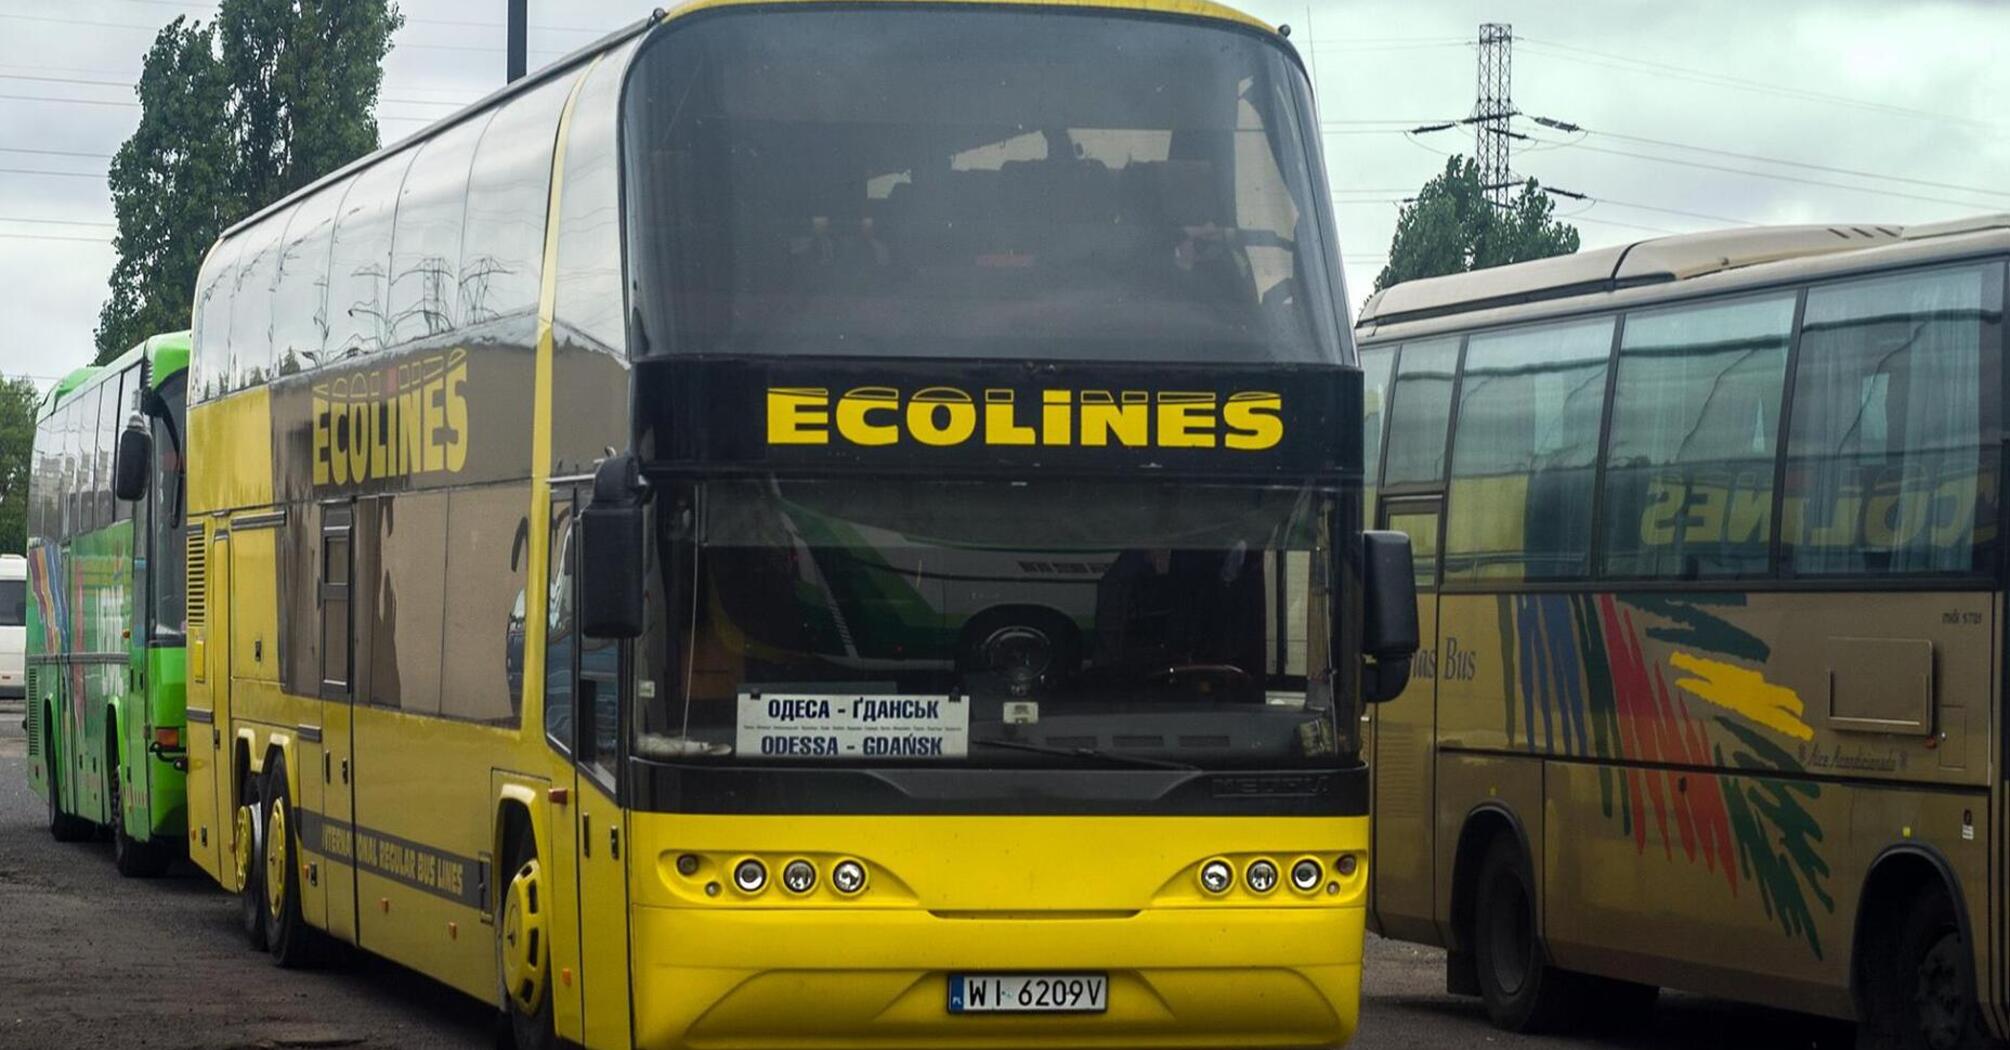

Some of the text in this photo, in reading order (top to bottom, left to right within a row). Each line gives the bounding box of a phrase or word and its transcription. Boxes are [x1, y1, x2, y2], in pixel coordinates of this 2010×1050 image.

[312, 347, 468, 487] ECOLINES
[767, 387, 1284, 451] ECOLINES
[1444, 637, 1477, 681] Bus
[768, 698, 830, 722] ОДЕСА
[852, 696, 939, 722] ҐДАНСЬК
[761, 735, 838, 756] ODESSA
[863, 733, 943, 757] GDAŃSK
[379, 841, 418, 879] REGULAR
[418, 851, 436, 887] BUS
[438, 857, 463, 896] LINES
[969, 979, 1102, 1007] WI 6209V
